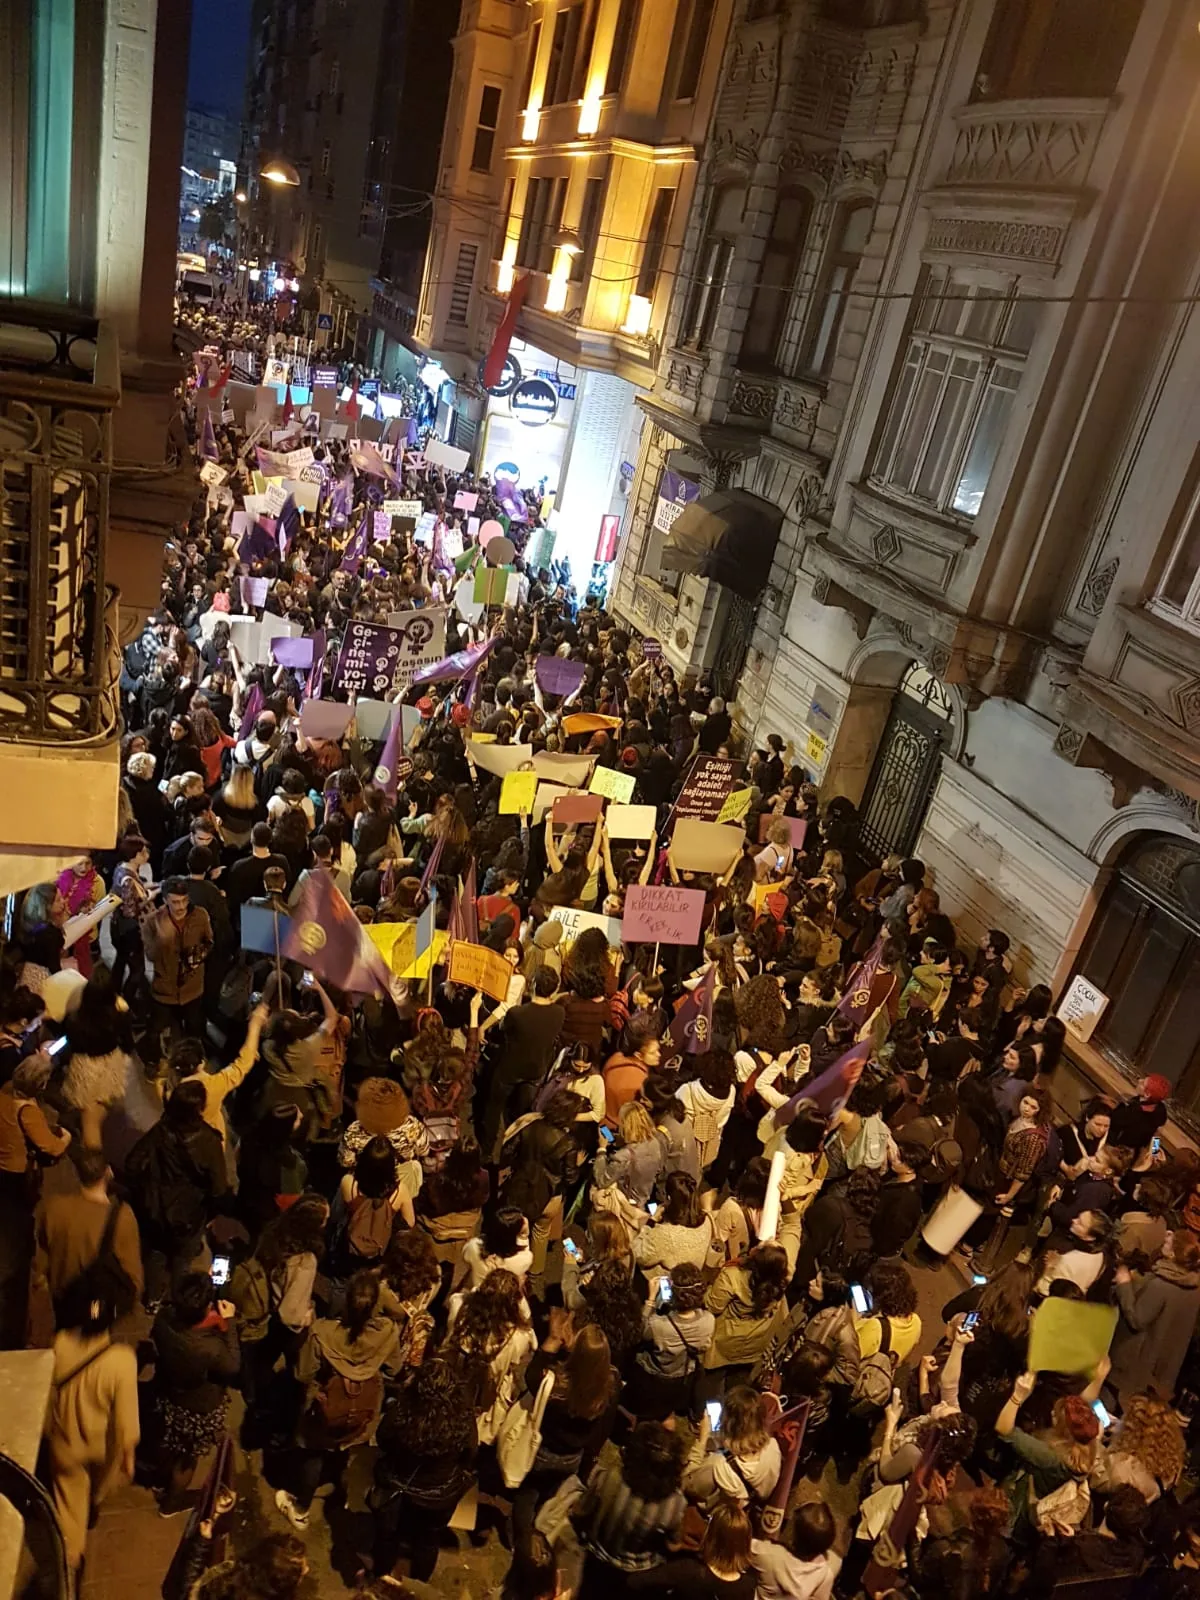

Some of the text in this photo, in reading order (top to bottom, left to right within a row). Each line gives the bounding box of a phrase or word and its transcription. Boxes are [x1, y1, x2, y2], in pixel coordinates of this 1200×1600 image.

[352, 624, 378, 637] Ge-
[353, 636, 372, 650] çi-
[348, 648, 372, 658] ne-
[345, 657, 369, 669] mi-
[343, 669, 367, 680] yo-
[338, 679, 367, 690] ruz!
[705, 760, 733, 773] Eşitliği
[694, 770, 732, 782] yok sayan
[696, 779, 723, 789] adaleti
